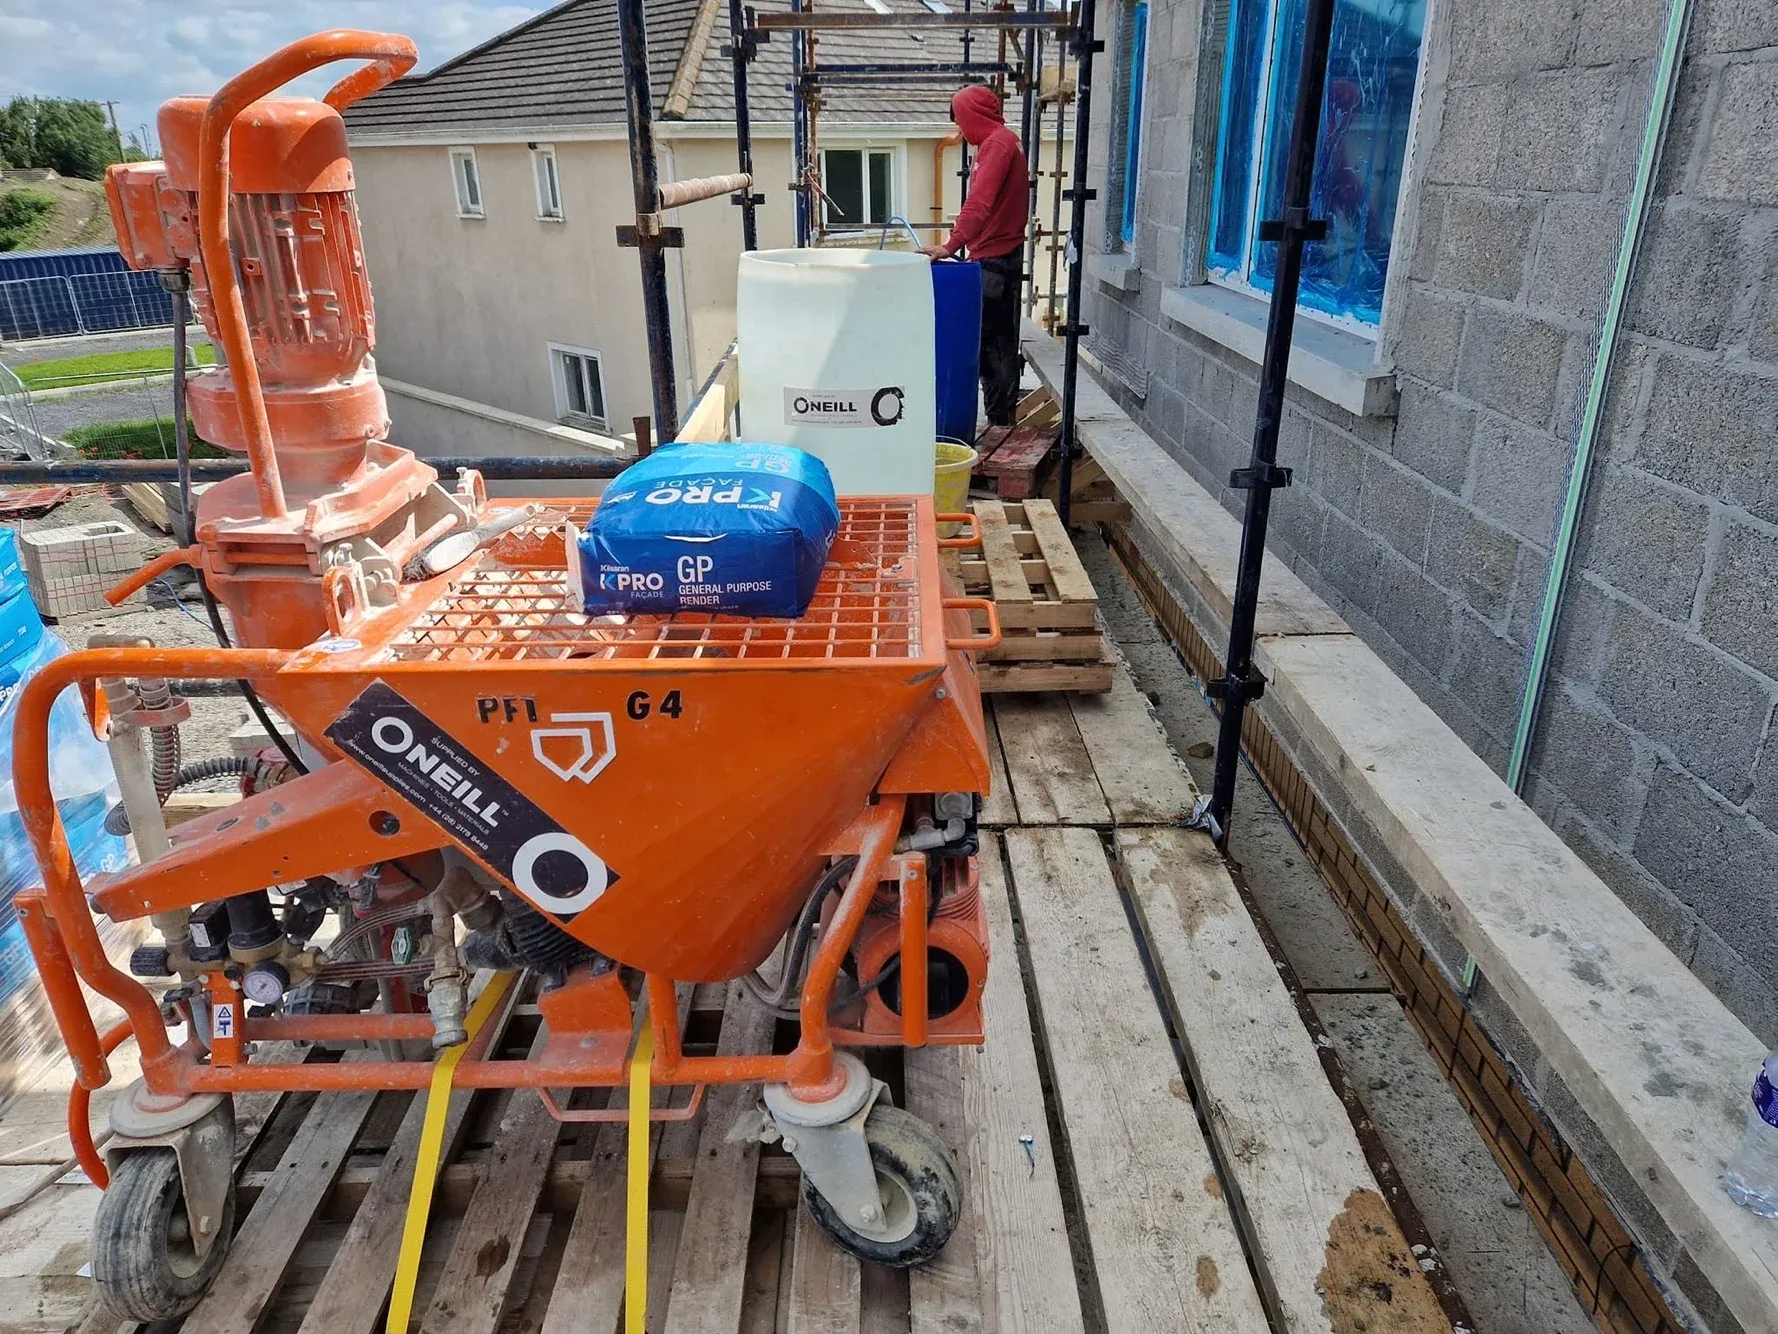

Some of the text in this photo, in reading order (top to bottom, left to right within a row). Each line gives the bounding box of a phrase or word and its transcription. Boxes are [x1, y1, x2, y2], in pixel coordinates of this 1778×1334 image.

[793, 396, 858, 415] ONEILL
[654, 477, 744, 489] FAÇADE
[600, 565, 630, 573] Kilsaran
[676, 555, 714, 584] GP
[630, 591, 664, 599] FAÇADE
[678, 581, 772, 595] GENERAL PURPOSE
[679, 595, 720, 606] RENDER
[431, 736, 481, 777] SUPPLIED BY
[371, 716, 501, 828] ONEILL
[397, 761, 491, 836] MACHINES TOOLS MATERIALS
